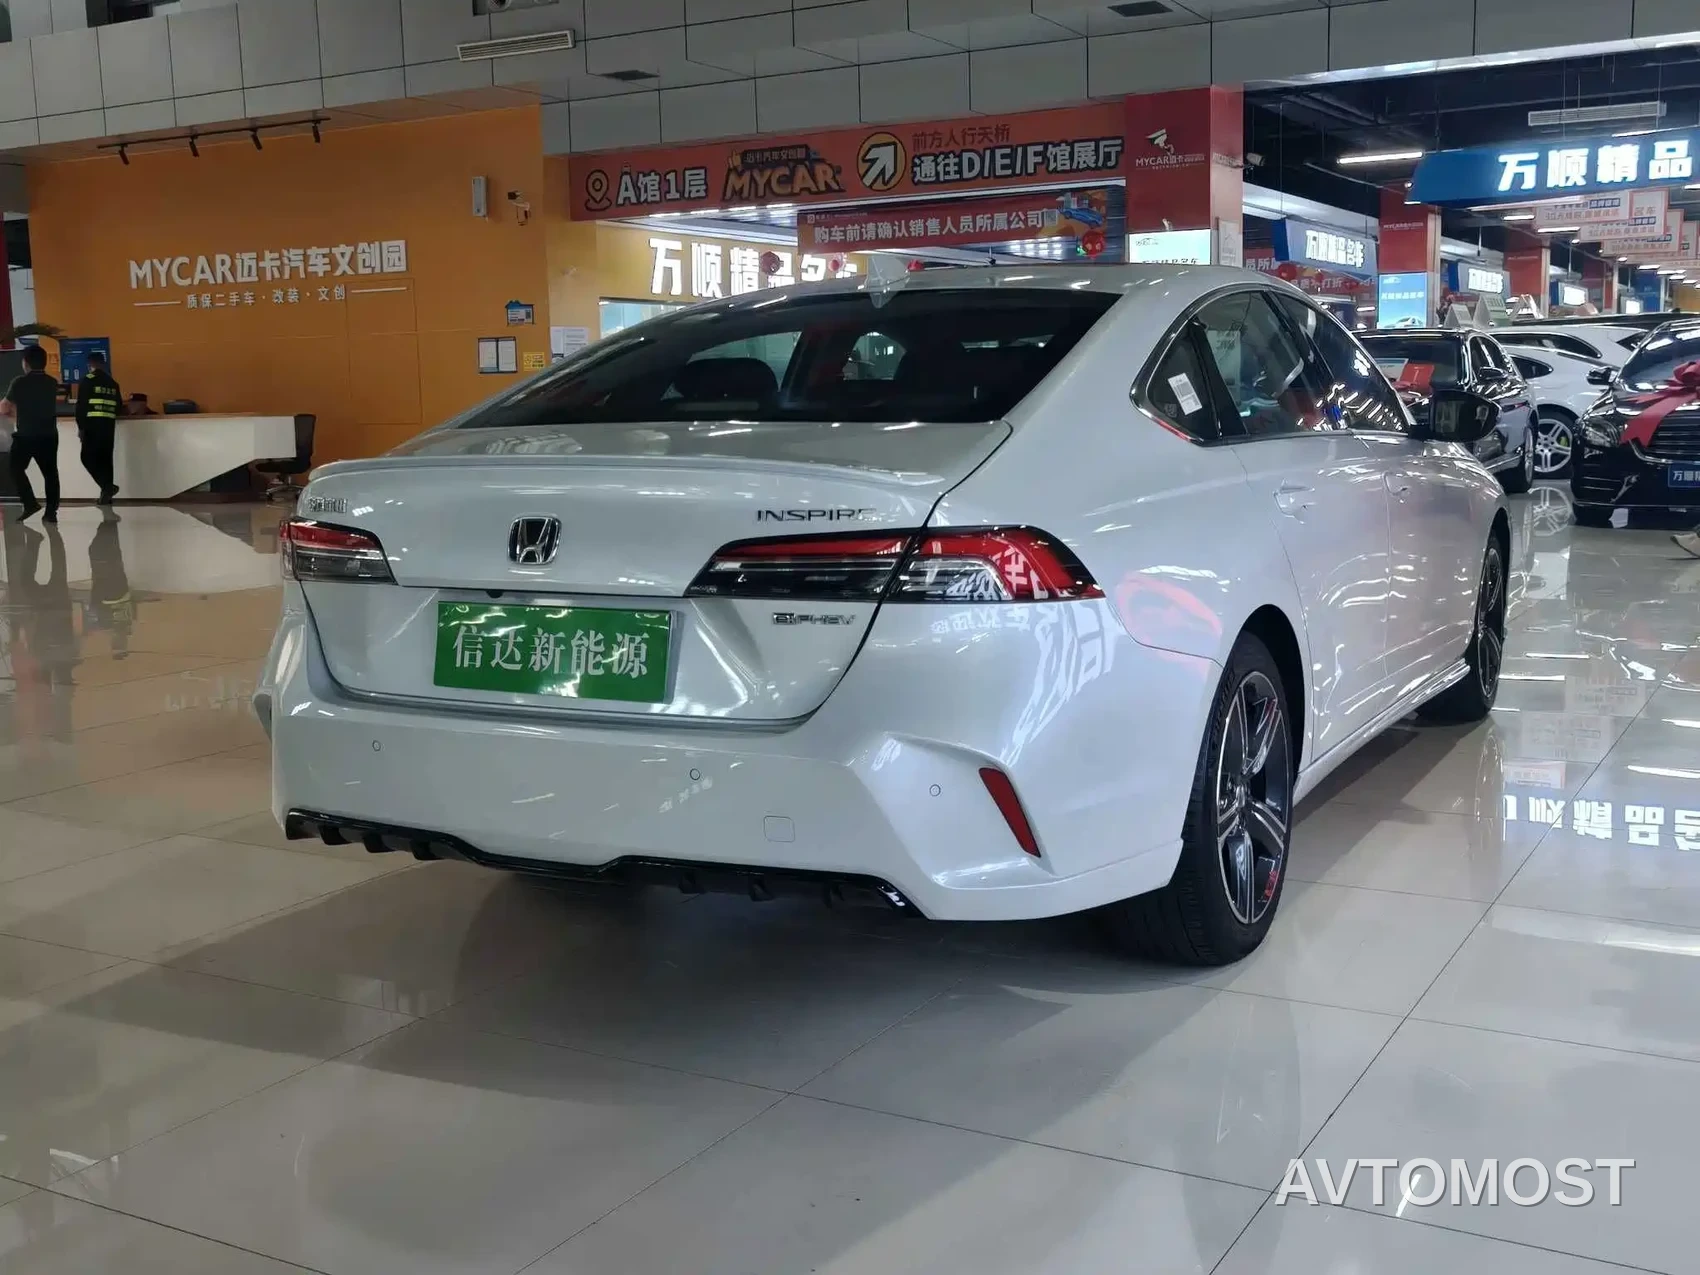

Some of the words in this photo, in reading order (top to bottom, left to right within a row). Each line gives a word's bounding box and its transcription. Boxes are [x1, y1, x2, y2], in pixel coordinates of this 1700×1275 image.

[912, 124, 1010, 150] 前方人行天桥
[724, 163, 843, 201] MYCAR
[913, 139, 1123, 183] 通往D/E/F馆展厅
[129, 240, 408, 290] MYCAR迈卡汽车文创园
[649, 237, 858, 299] 万顺精品名
[453, 623, 649, 678] 信达新能源
